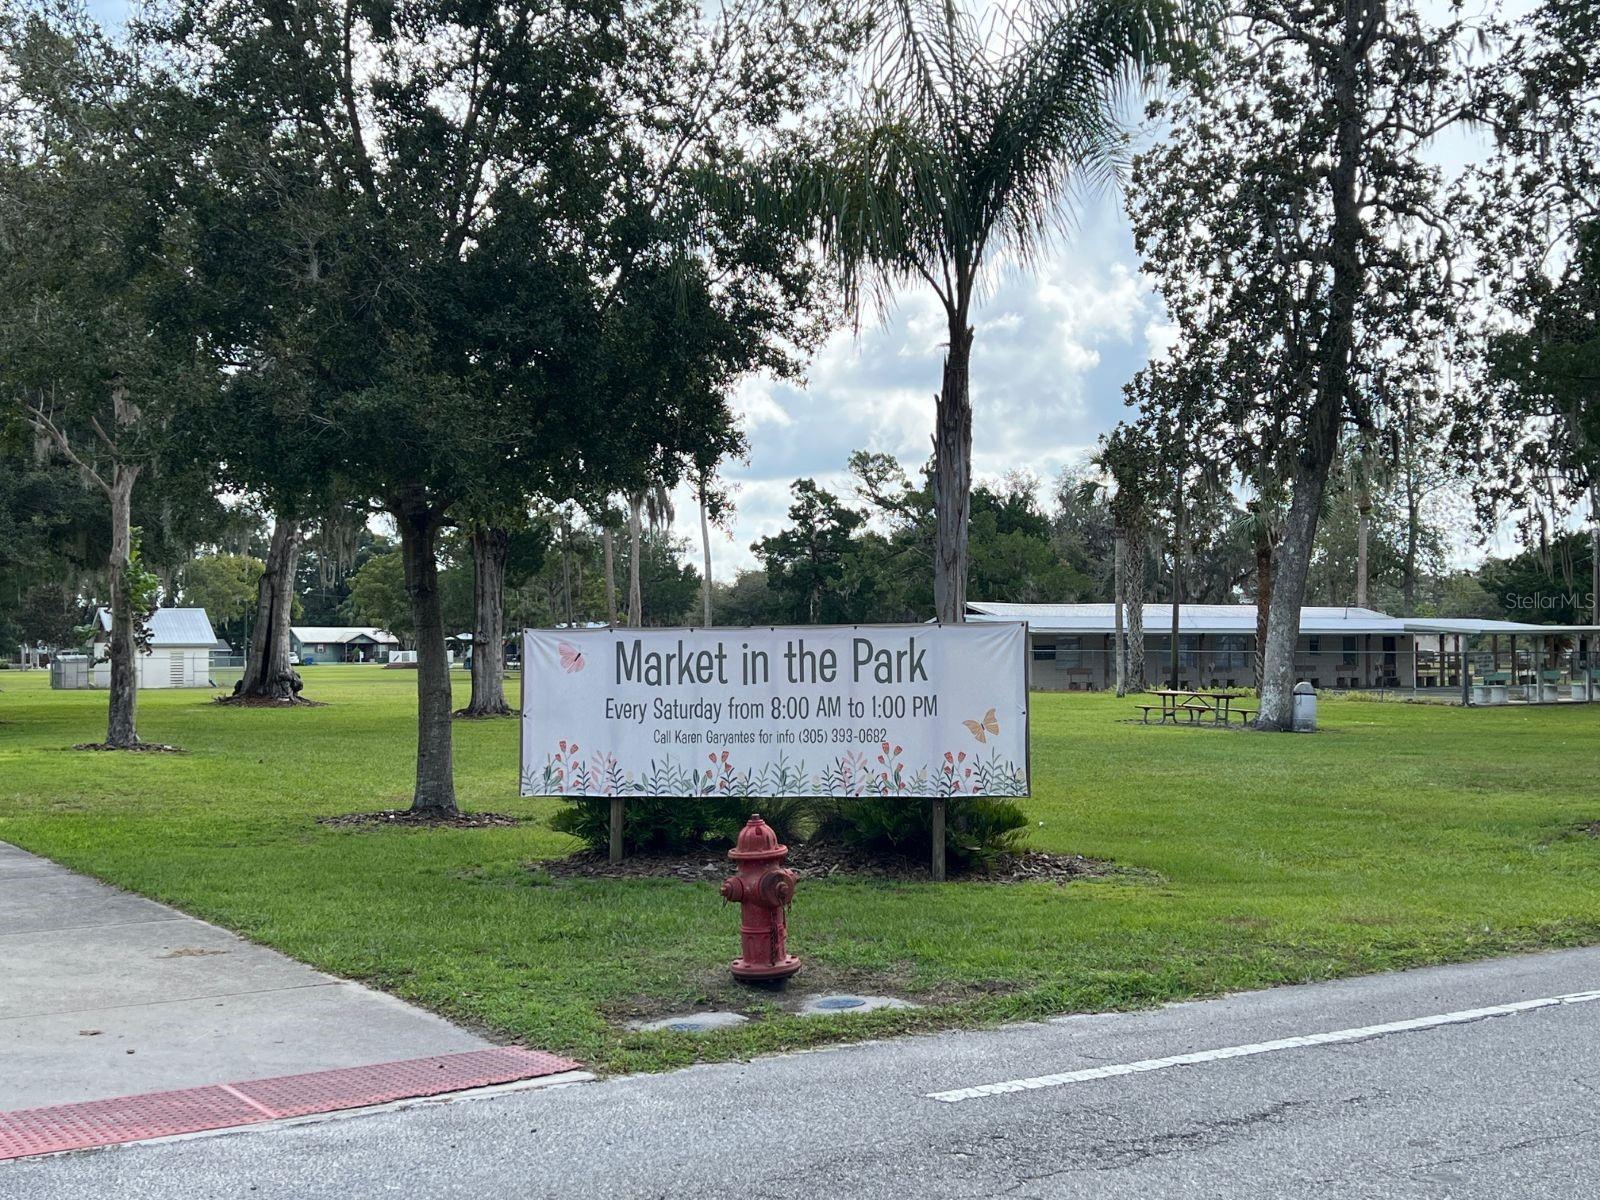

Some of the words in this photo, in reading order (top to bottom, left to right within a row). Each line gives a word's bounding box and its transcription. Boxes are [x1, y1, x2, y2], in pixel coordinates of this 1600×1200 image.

[616, 639, 728, 686] Market
[742, 642, 769, 685] in
[784, 639, 837, 684] the
[853, 637, 928, 684] Park
[605, 698, 647, 724] Every
[653, 697, 722, 724] Saturday
[728, 697, 764, 719] from
[771, 696, 809, 720] 8:00
[816, 696, 841, 718] AM
[848, 697, 865, 719] to
[872, 695, 905, 719] 1:00
[913, 695, 938, 718] PM
[654, 729, 671, 744] Call
[675, 730, 702, 744] Karen
[706, 729, 755, 747] Garyantes
[759, 729, 773, 744] for
[777, 729, 795, 744] info
[798, 728, 828, 744] (305)
[832, 728, 887, 744] 393-0682
